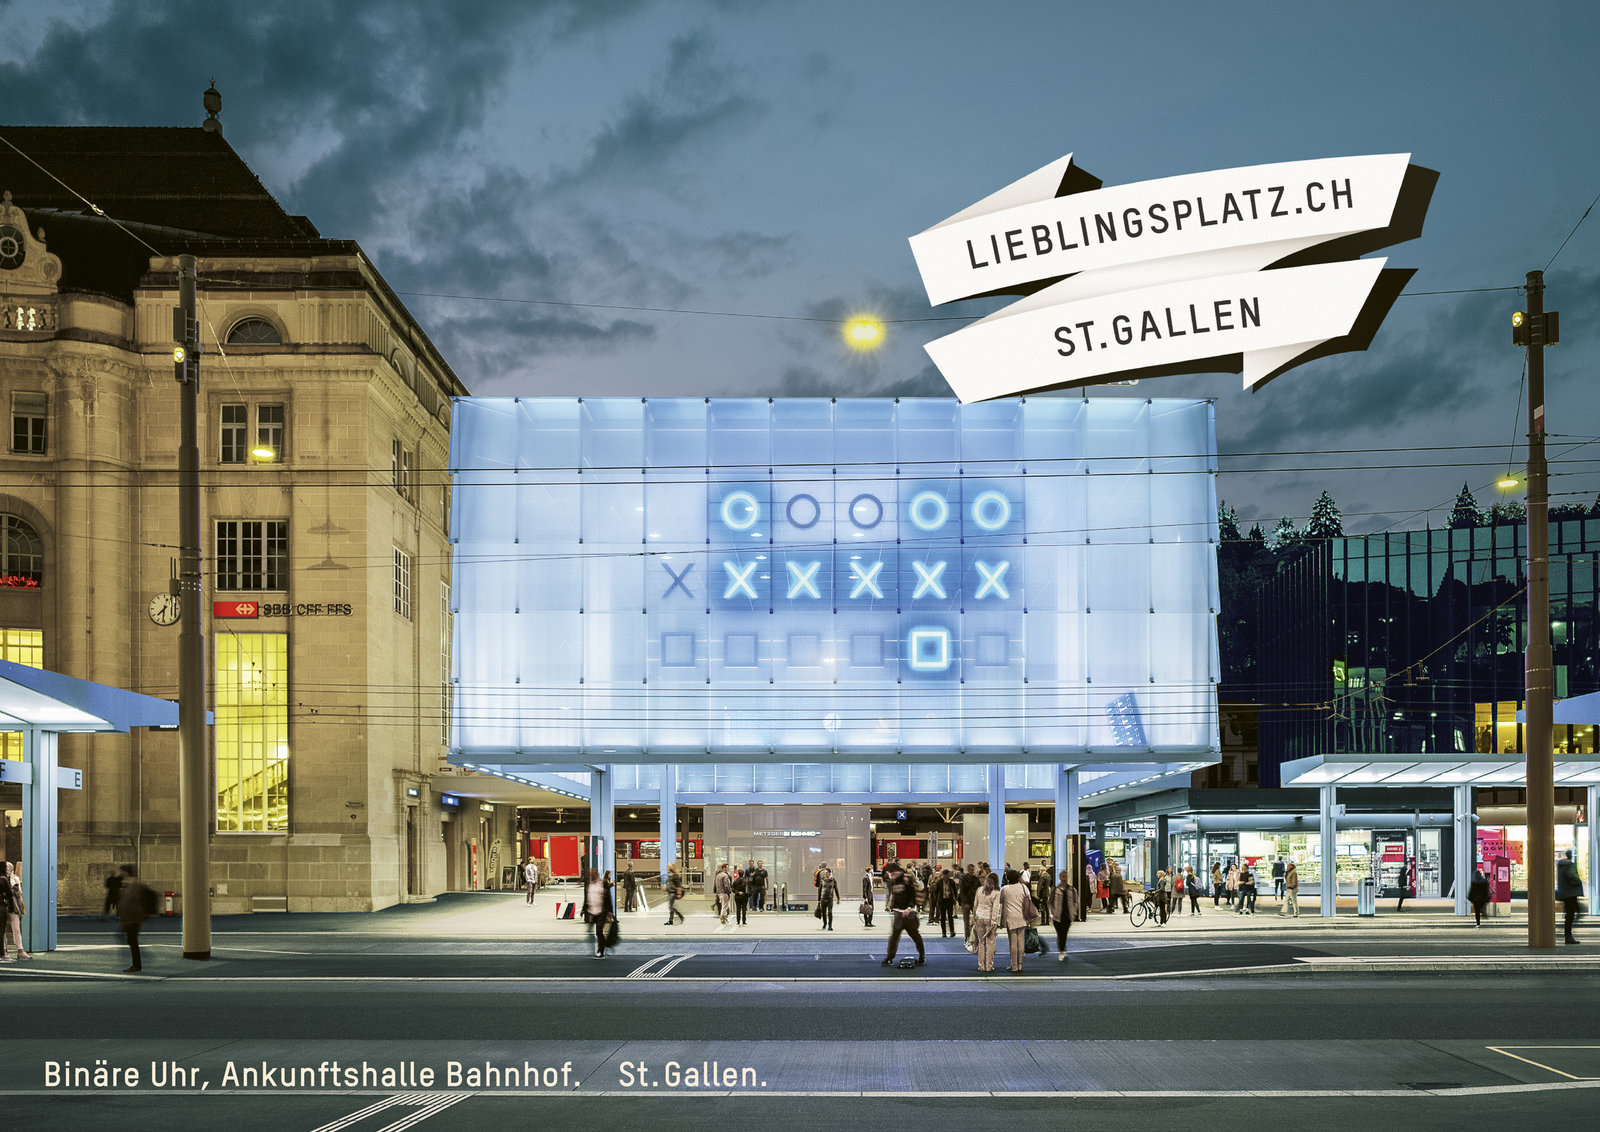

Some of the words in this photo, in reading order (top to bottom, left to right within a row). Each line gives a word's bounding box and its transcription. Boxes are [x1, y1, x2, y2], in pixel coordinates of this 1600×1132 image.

[263, 604, 292, 616] SBB
[297, 604, 322, 616] CFF
[327, 604, 353, 616] FFS
[75, 772, 81, 788] E
